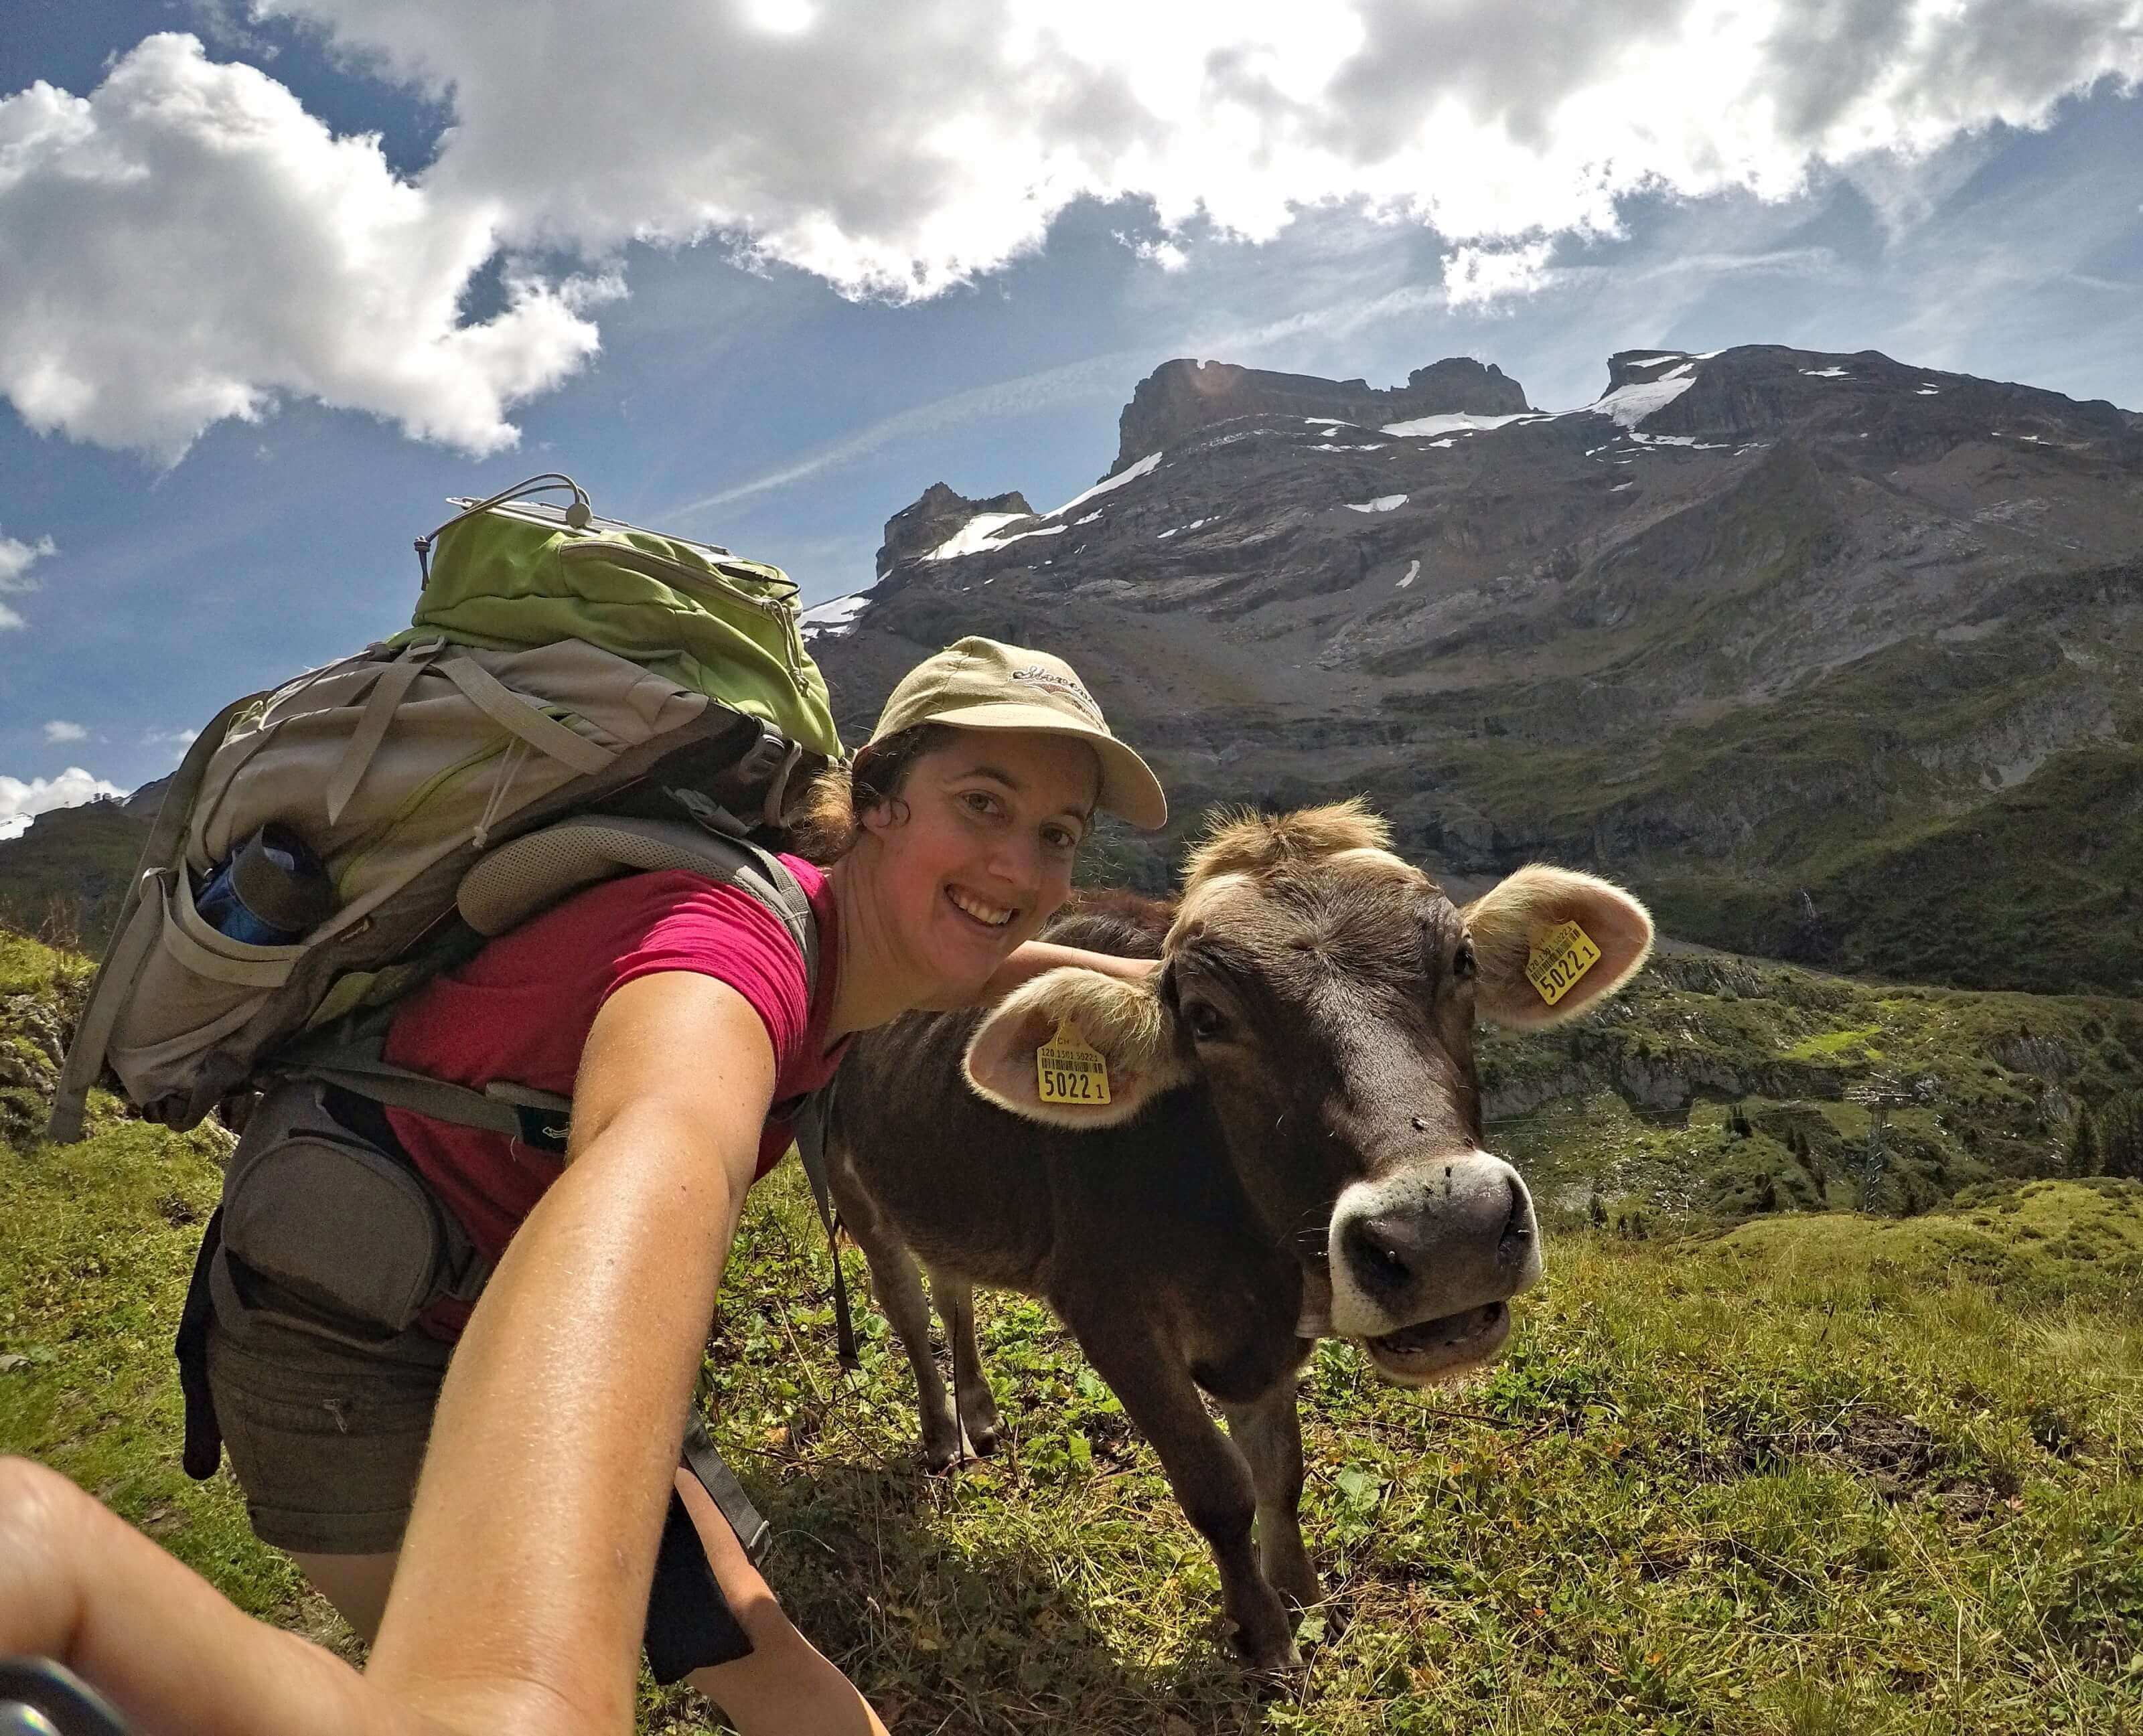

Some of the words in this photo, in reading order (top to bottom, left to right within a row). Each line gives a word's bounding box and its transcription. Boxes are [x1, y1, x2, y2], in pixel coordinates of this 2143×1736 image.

[1540, 950, 1585, 998] 5022
[1582, 945, 1595, 959] 1
[1041, 1048, 1055, 1057] 120
[1044, 1071, 1091, 1099] 5022
[1096, 1084, 1104, 1099] 1
